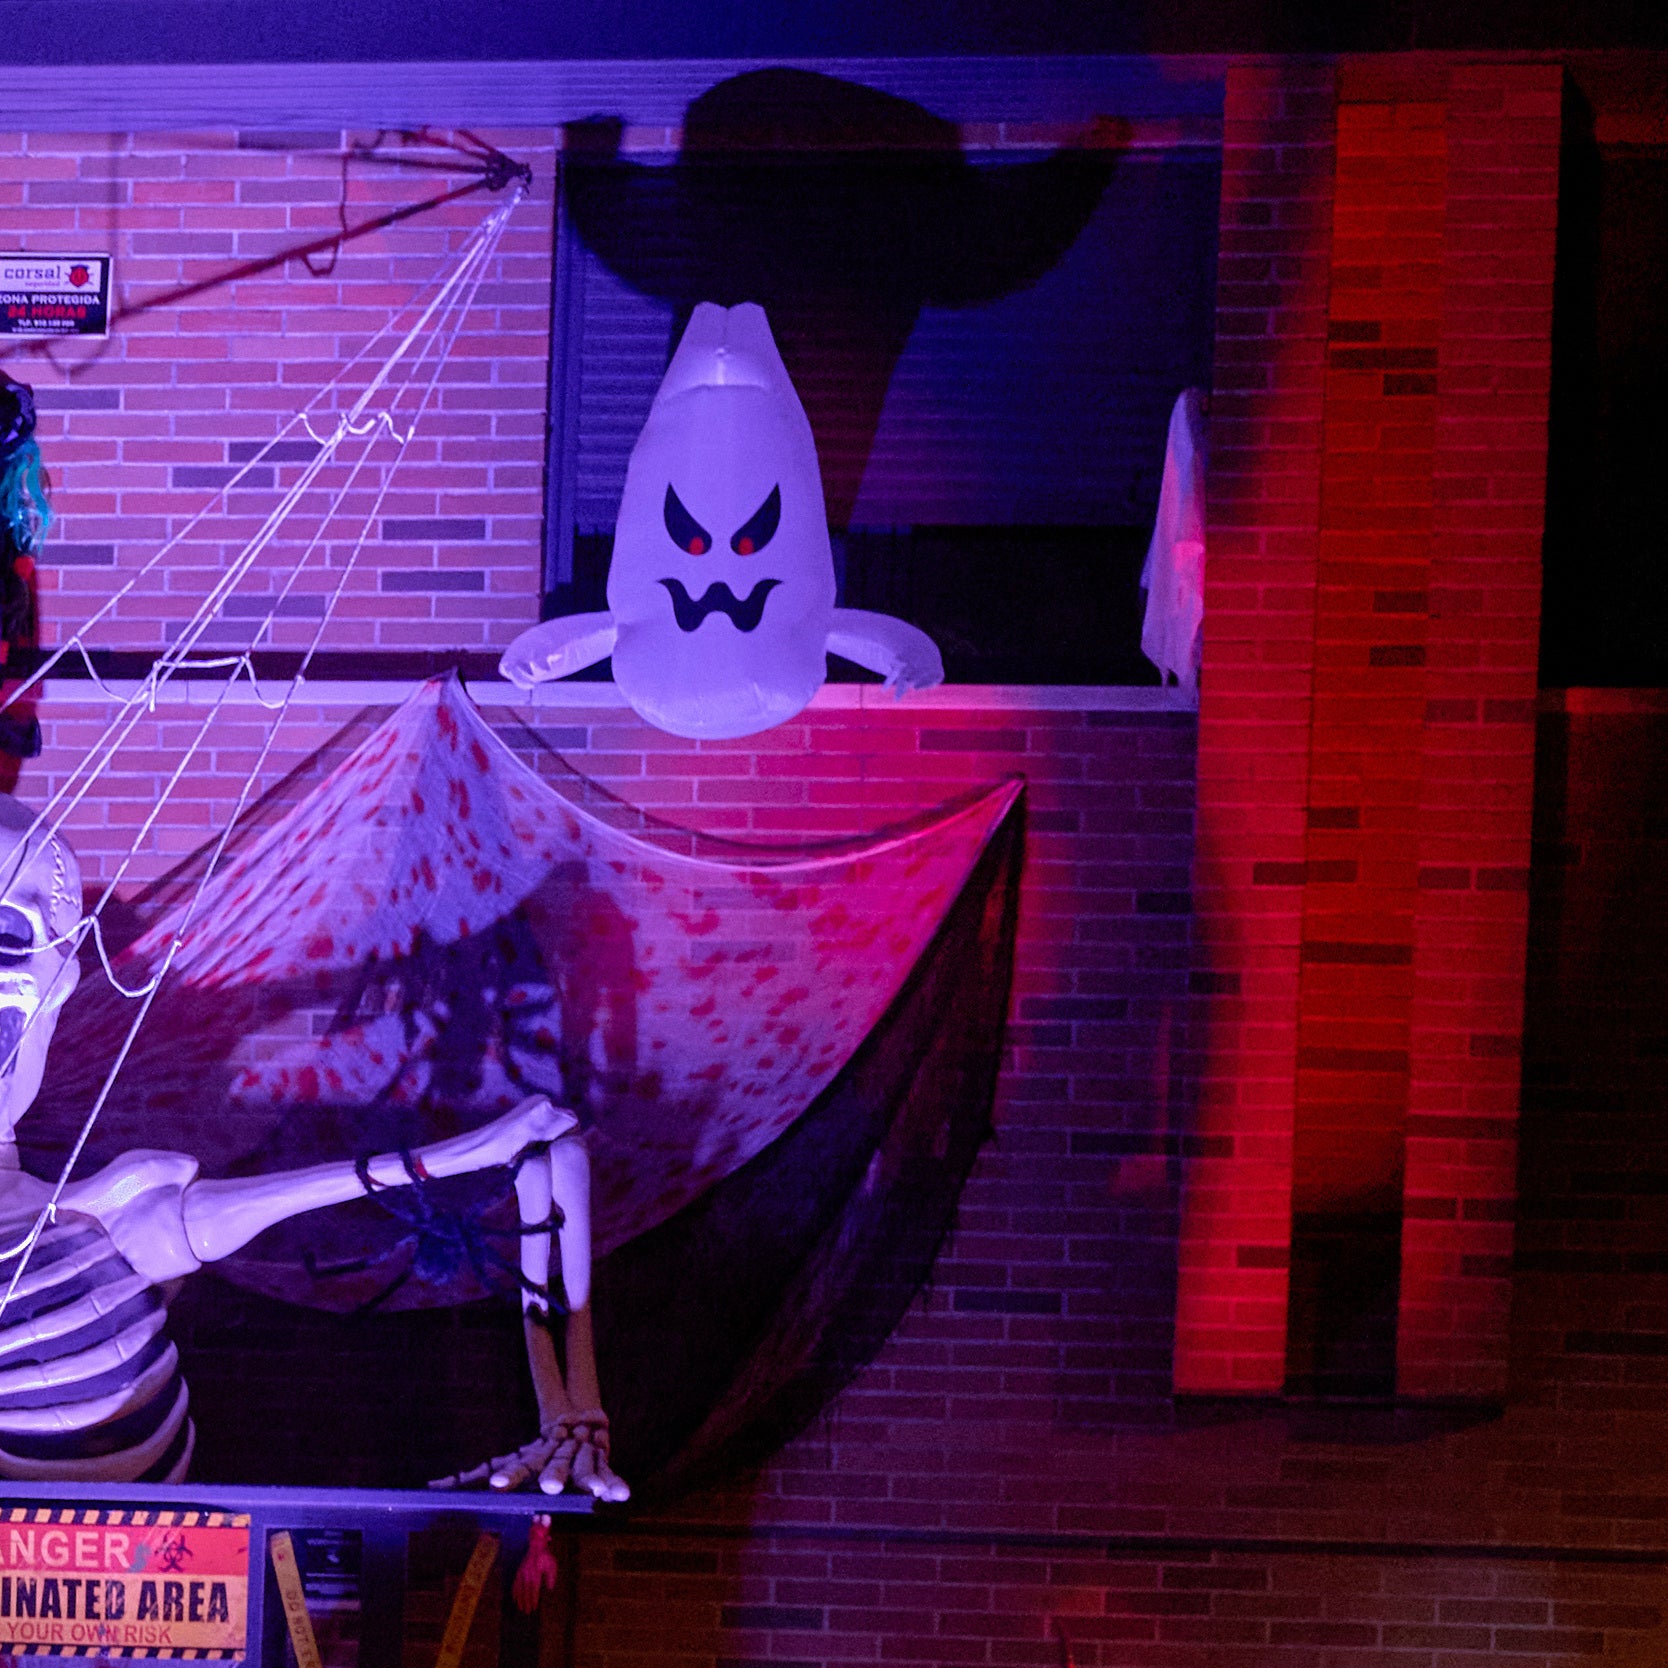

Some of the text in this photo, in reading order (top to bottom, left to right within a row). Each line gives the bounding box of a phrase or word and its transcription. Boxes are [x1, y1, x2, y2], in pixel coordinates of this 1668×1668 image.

[4, 265, 60, 279] corsal
[30, 294, 100, 305] PROTEGIDA
[136, 1580, 230, 1624] AREA
[7, 1621, 63, 1641] YOUR
[71, 1623, 120, 1643] OWN
[124, 1624, 172, 1645] RISK
